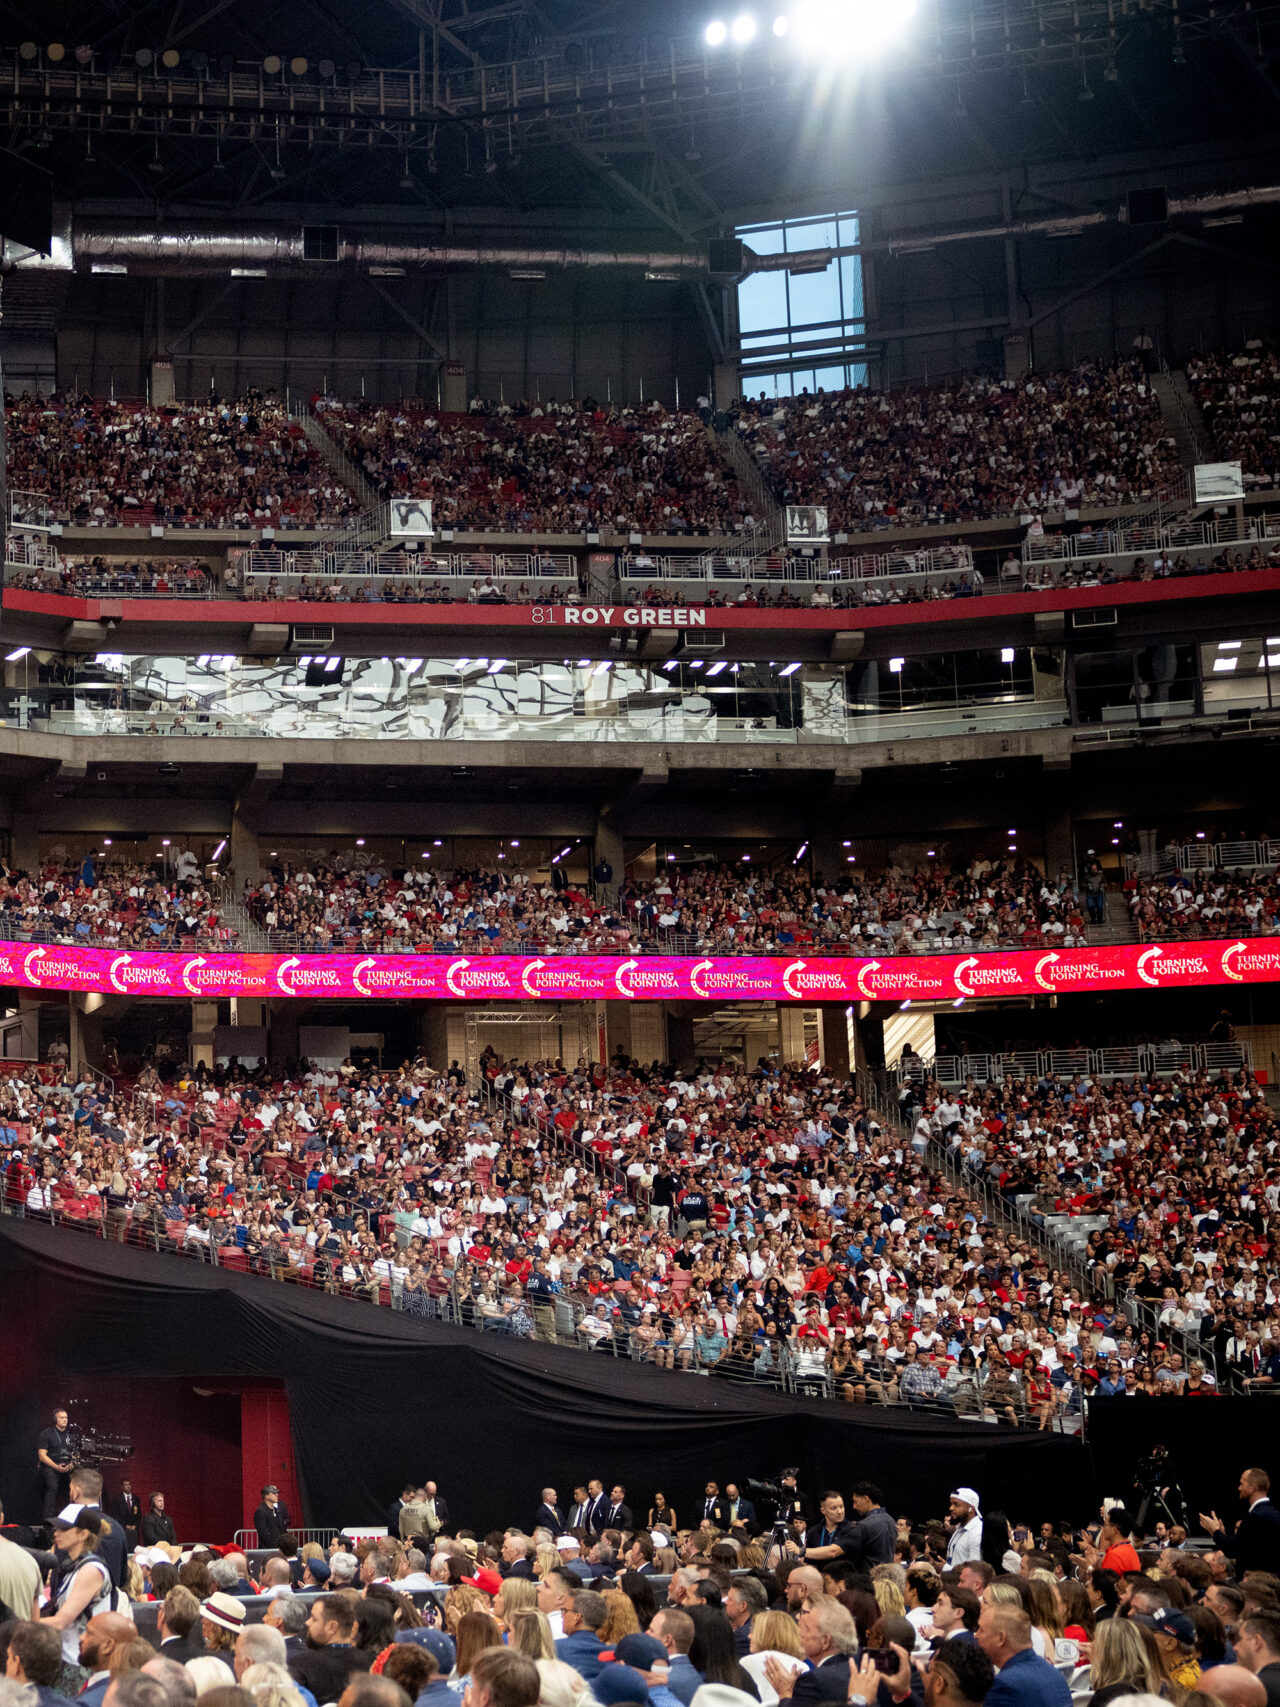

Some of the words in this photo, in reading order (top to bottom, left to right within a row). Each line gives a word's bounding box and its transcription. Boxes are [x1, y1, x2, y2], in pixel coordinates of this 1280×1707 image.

[531, 607, 557, 624] 81
[564, 607, 615, 625] ROY
[623, 608, 706, 626] GREEN
[37, 960, 79, 972] TURNING
[1152, 957, 1203, 968] TURNING
[1237, 961, 1271, 970] POINT
[122, 967, 167, 977] TURNING
[968, 967, 1017, 978] TURNING
[1049, 963, 1099, 973] TURNING
[1153, 965, 1187, 975] POINT
[1188, 963, 1209, 973] USA
[37, 968, 65, 978] POINT
[66, 970, 100, 981] ACTION
[196, 969, 242, 978] TURNING
[290, 970, 336, 979] TURNING
[366, 971, 411, 979] TURNING
[460, 971, 506, 980] TURNING
[535, 972, 580, 980] TURNING
[628, 972, 674, 981] TURNING
[703, 973, 748, 981] TURNING
[796, 973, 841, 982] TURNING
[870, 973, 917, 982] TURNING
[1050, 971, 1084, 981] POINT
[1085, 969, 1125, 979] ACTION
[122, 974, 153, 984] POINT
[154, 975, 172, 985] USA
[197, 976, 228, 985] POINT
[229, 976, 266, 986] ACTION
[290, 977, 322, 986] POINT
[322, 977, 341, 986] USA
[366, 977, 398, 986] POINT
[398, 977, 435, 986] ACTION
[460, 978, 492, 987] POINT
[492, 978, 510, 987] USA
[535, 979, 567, 988] POINT
[568, 979, 604, 988] ACTION
[629, 979, 660, 988] POINT
[661, 979, 679, 988] USA
[871, 980, 903, 989] POINT
[904, 979, 942, 988] ACTION
[969, 975, 1000, 985] POINT
[1002, 974, 1022, 983] USA
[704, 980, 735, 988] POINT
[736, 980, 772, 989] ACTION
[796, 980, 827, 989] POINT
[828, 980, 846, 989] USA
